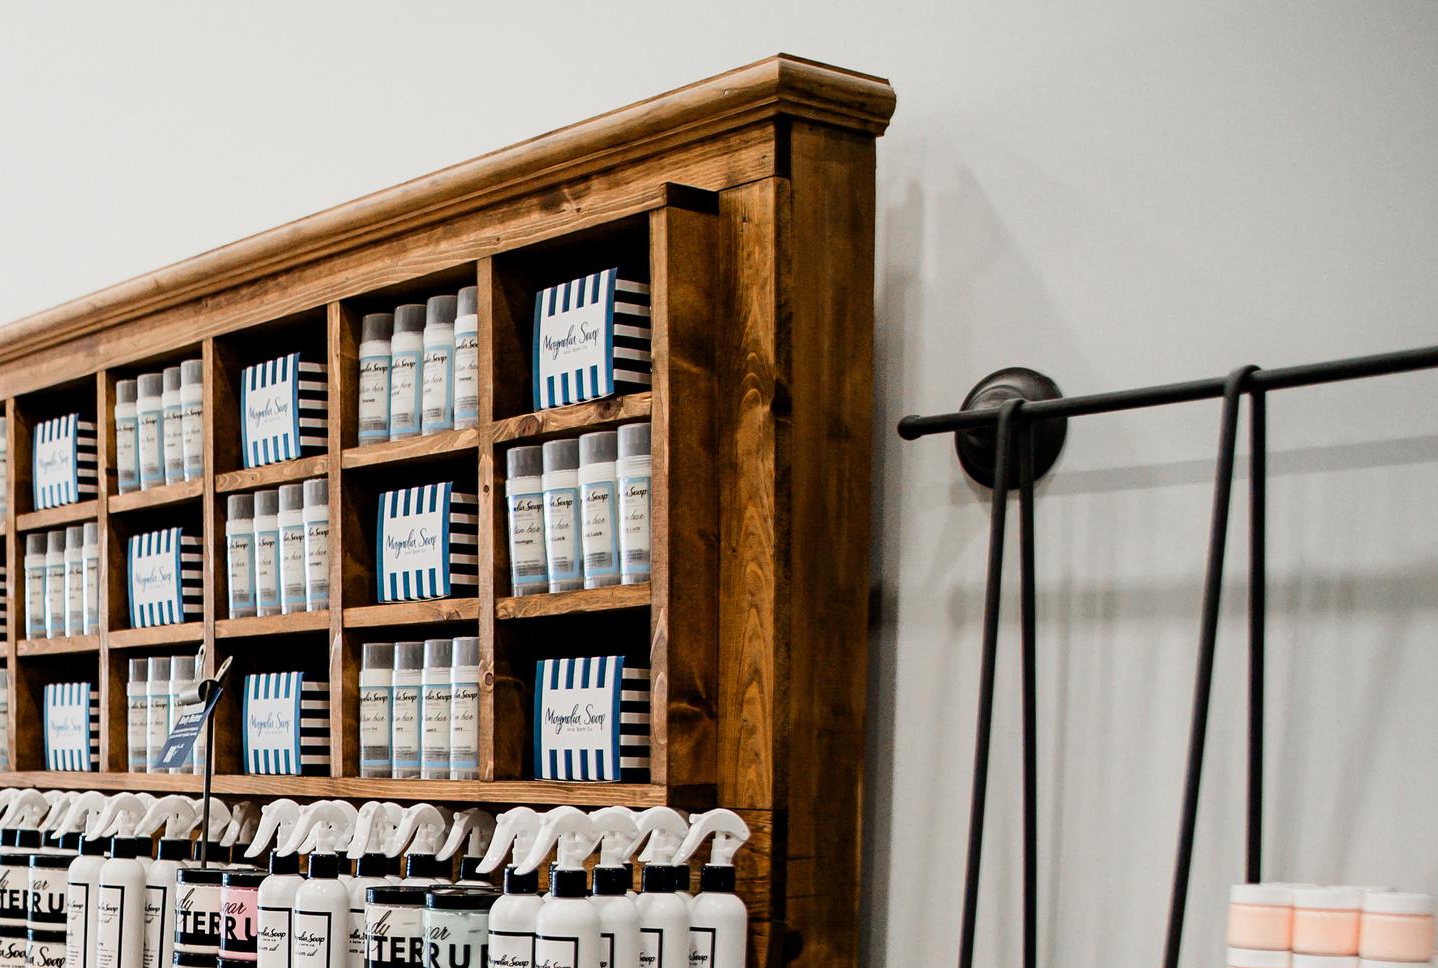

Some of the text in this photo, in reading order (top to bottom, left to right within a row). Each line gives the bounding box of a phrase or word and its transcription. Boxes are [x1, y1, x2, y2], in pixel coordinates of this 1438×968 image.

[579, 321, 599, 346] Soap
[545, 703, 606, 735] Magnolia Soap
[180, 911, 221, 934] TER
[371, 936, 423, 962] TER
